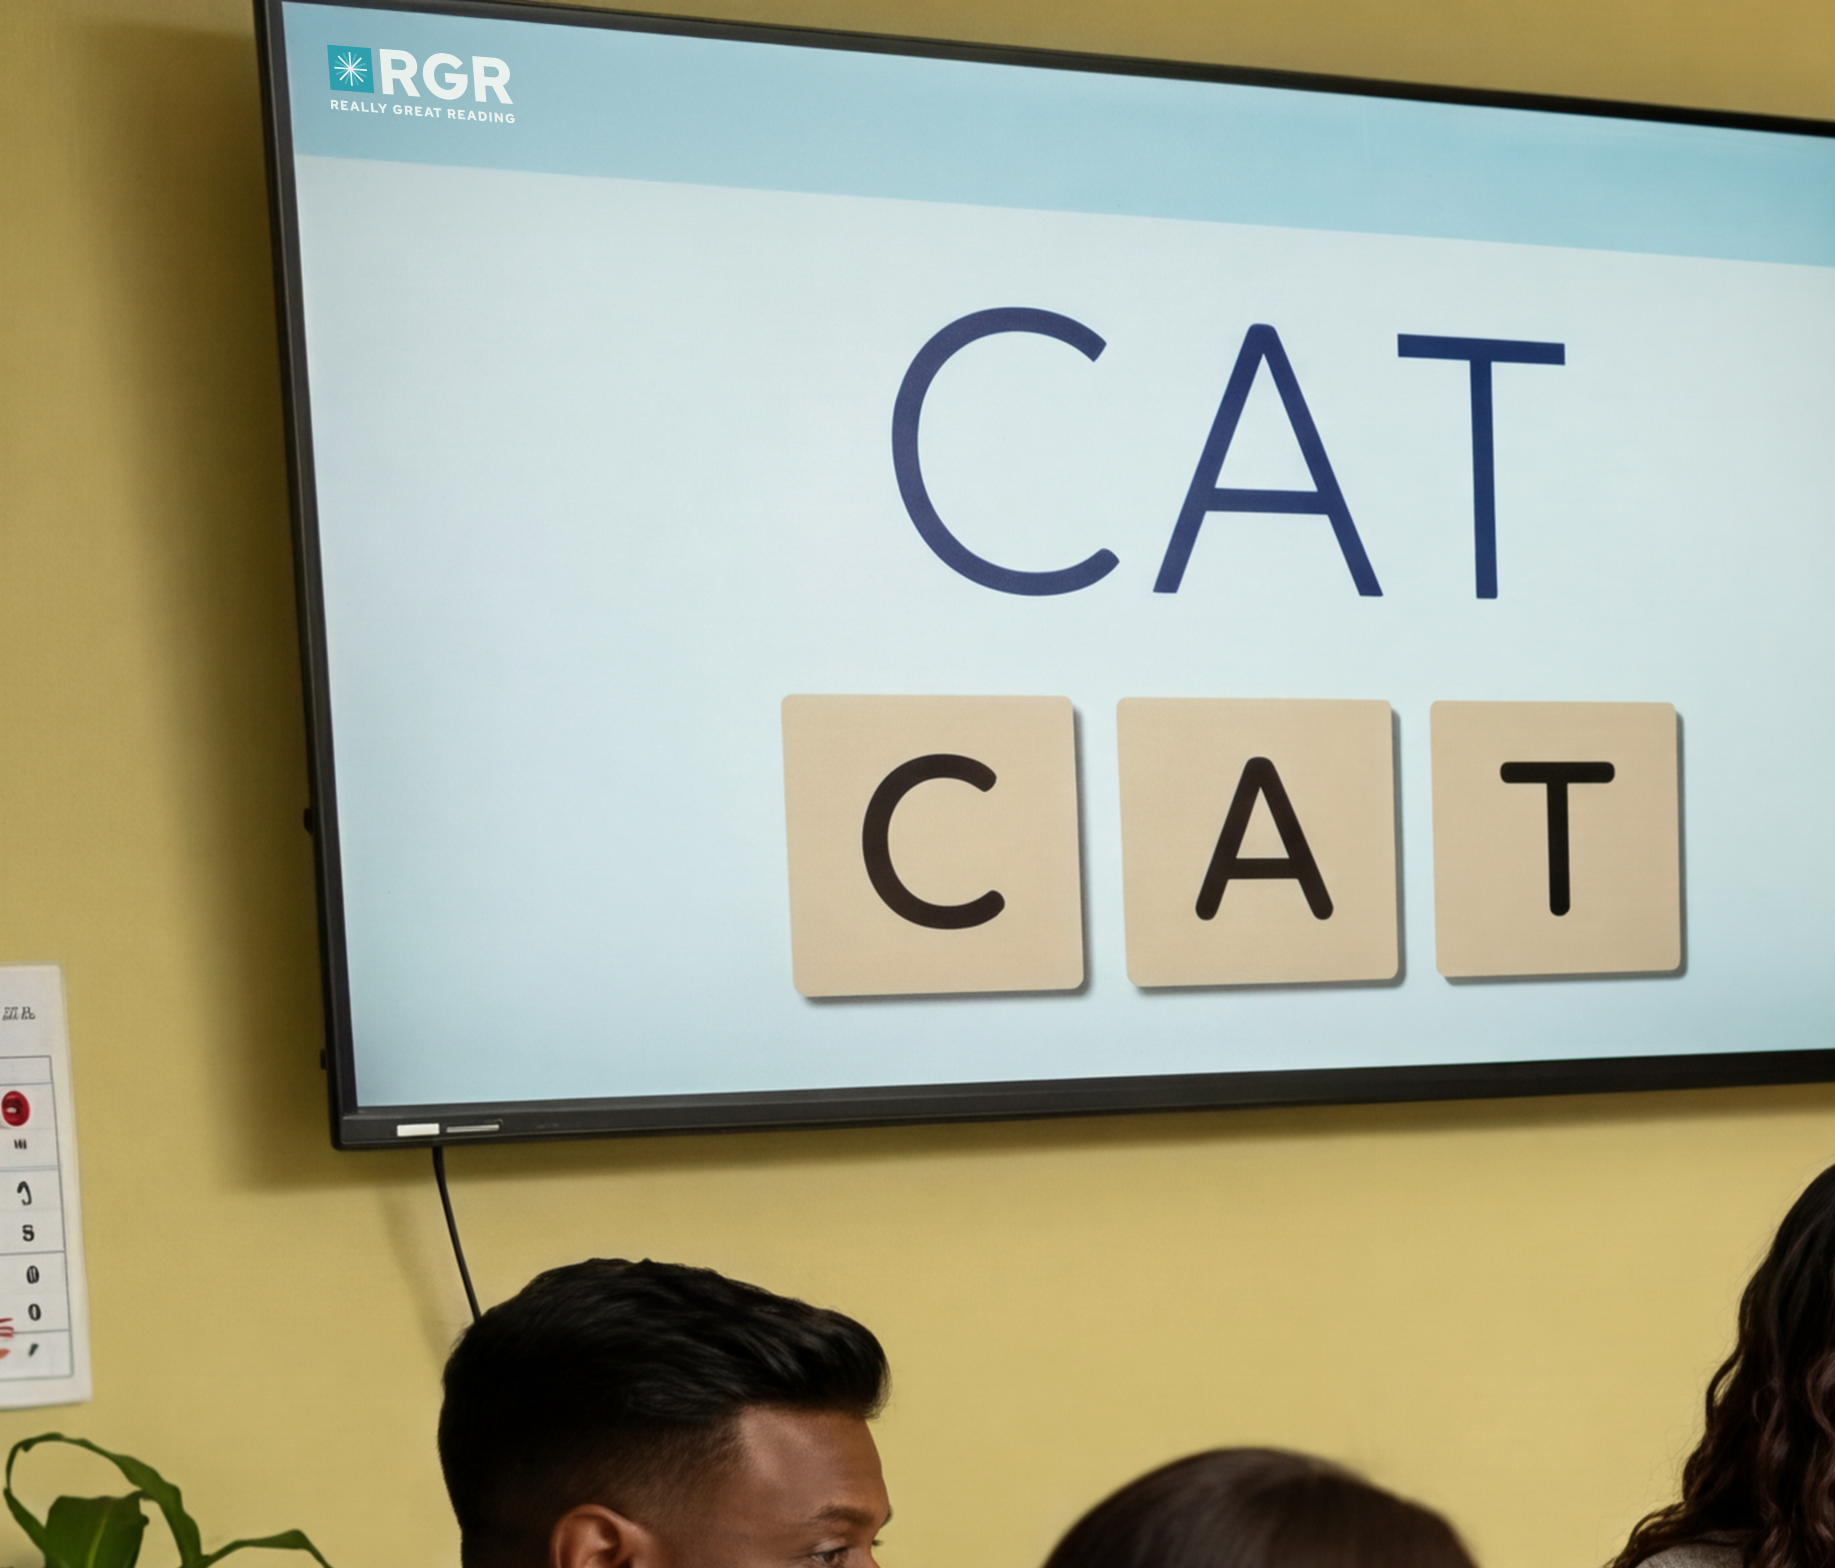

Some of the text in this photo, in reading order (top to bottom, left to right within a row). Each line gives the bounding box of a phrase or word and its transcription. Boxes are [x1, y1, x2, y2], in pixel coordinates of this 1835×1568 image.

[330, 99, 516, 124] REALLY GREAT READING
[379, 48, 514, 105] RGR
[891, 306, 1566, 600] CAT
[861, 753, 1616, 931] C A T
